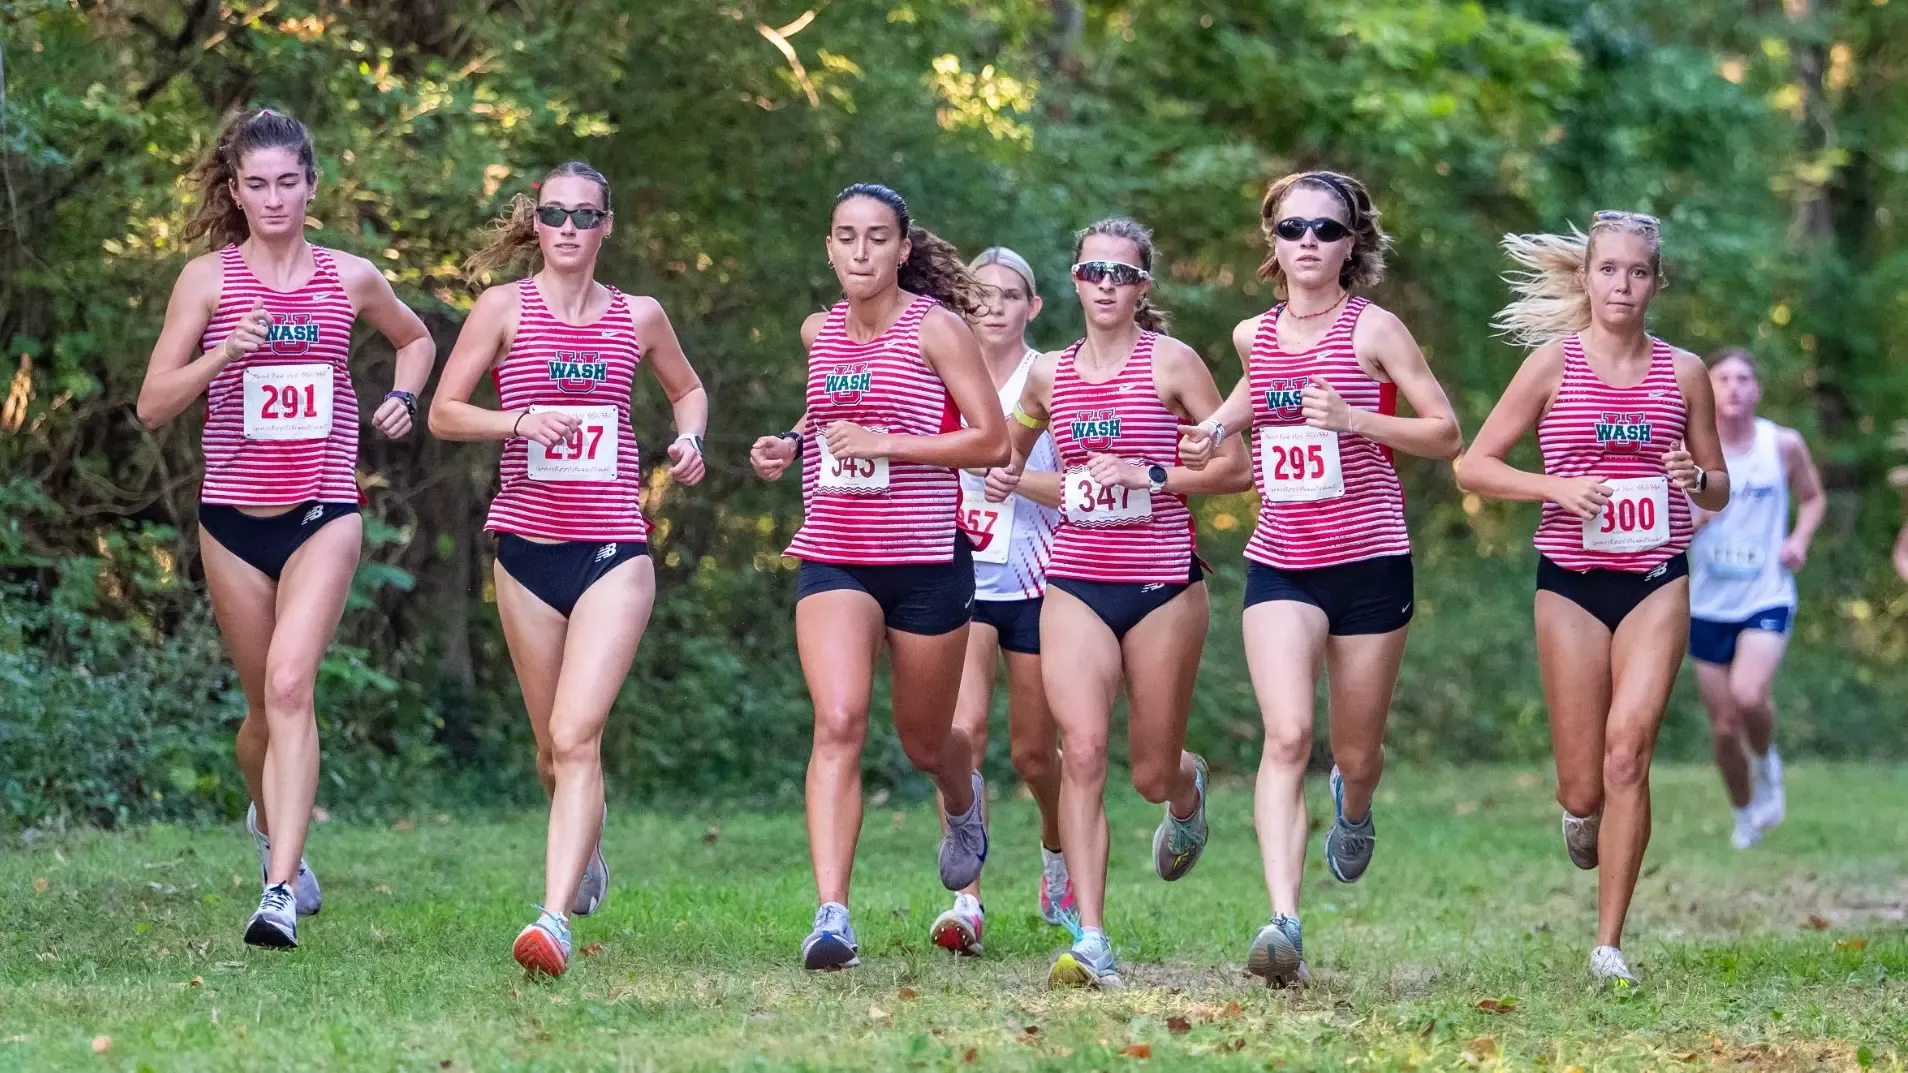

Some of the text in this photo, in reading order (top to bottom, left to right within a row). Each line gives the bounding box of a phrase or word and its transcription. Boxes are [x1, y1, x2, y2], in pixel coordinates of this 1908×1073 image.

[549, 361, 607, 381] WASH
[825, 373, 872, 393] WASH
[261, 384, 317, 419] 291
[1265, 390, 1303, 409] WAS
[1071, 419, 1121, 440] WASH
[1595, 424, 1652, 442] WASH
[1272, 444, 1325, 480] 295
[1600, 497, 1655, 533] 300
